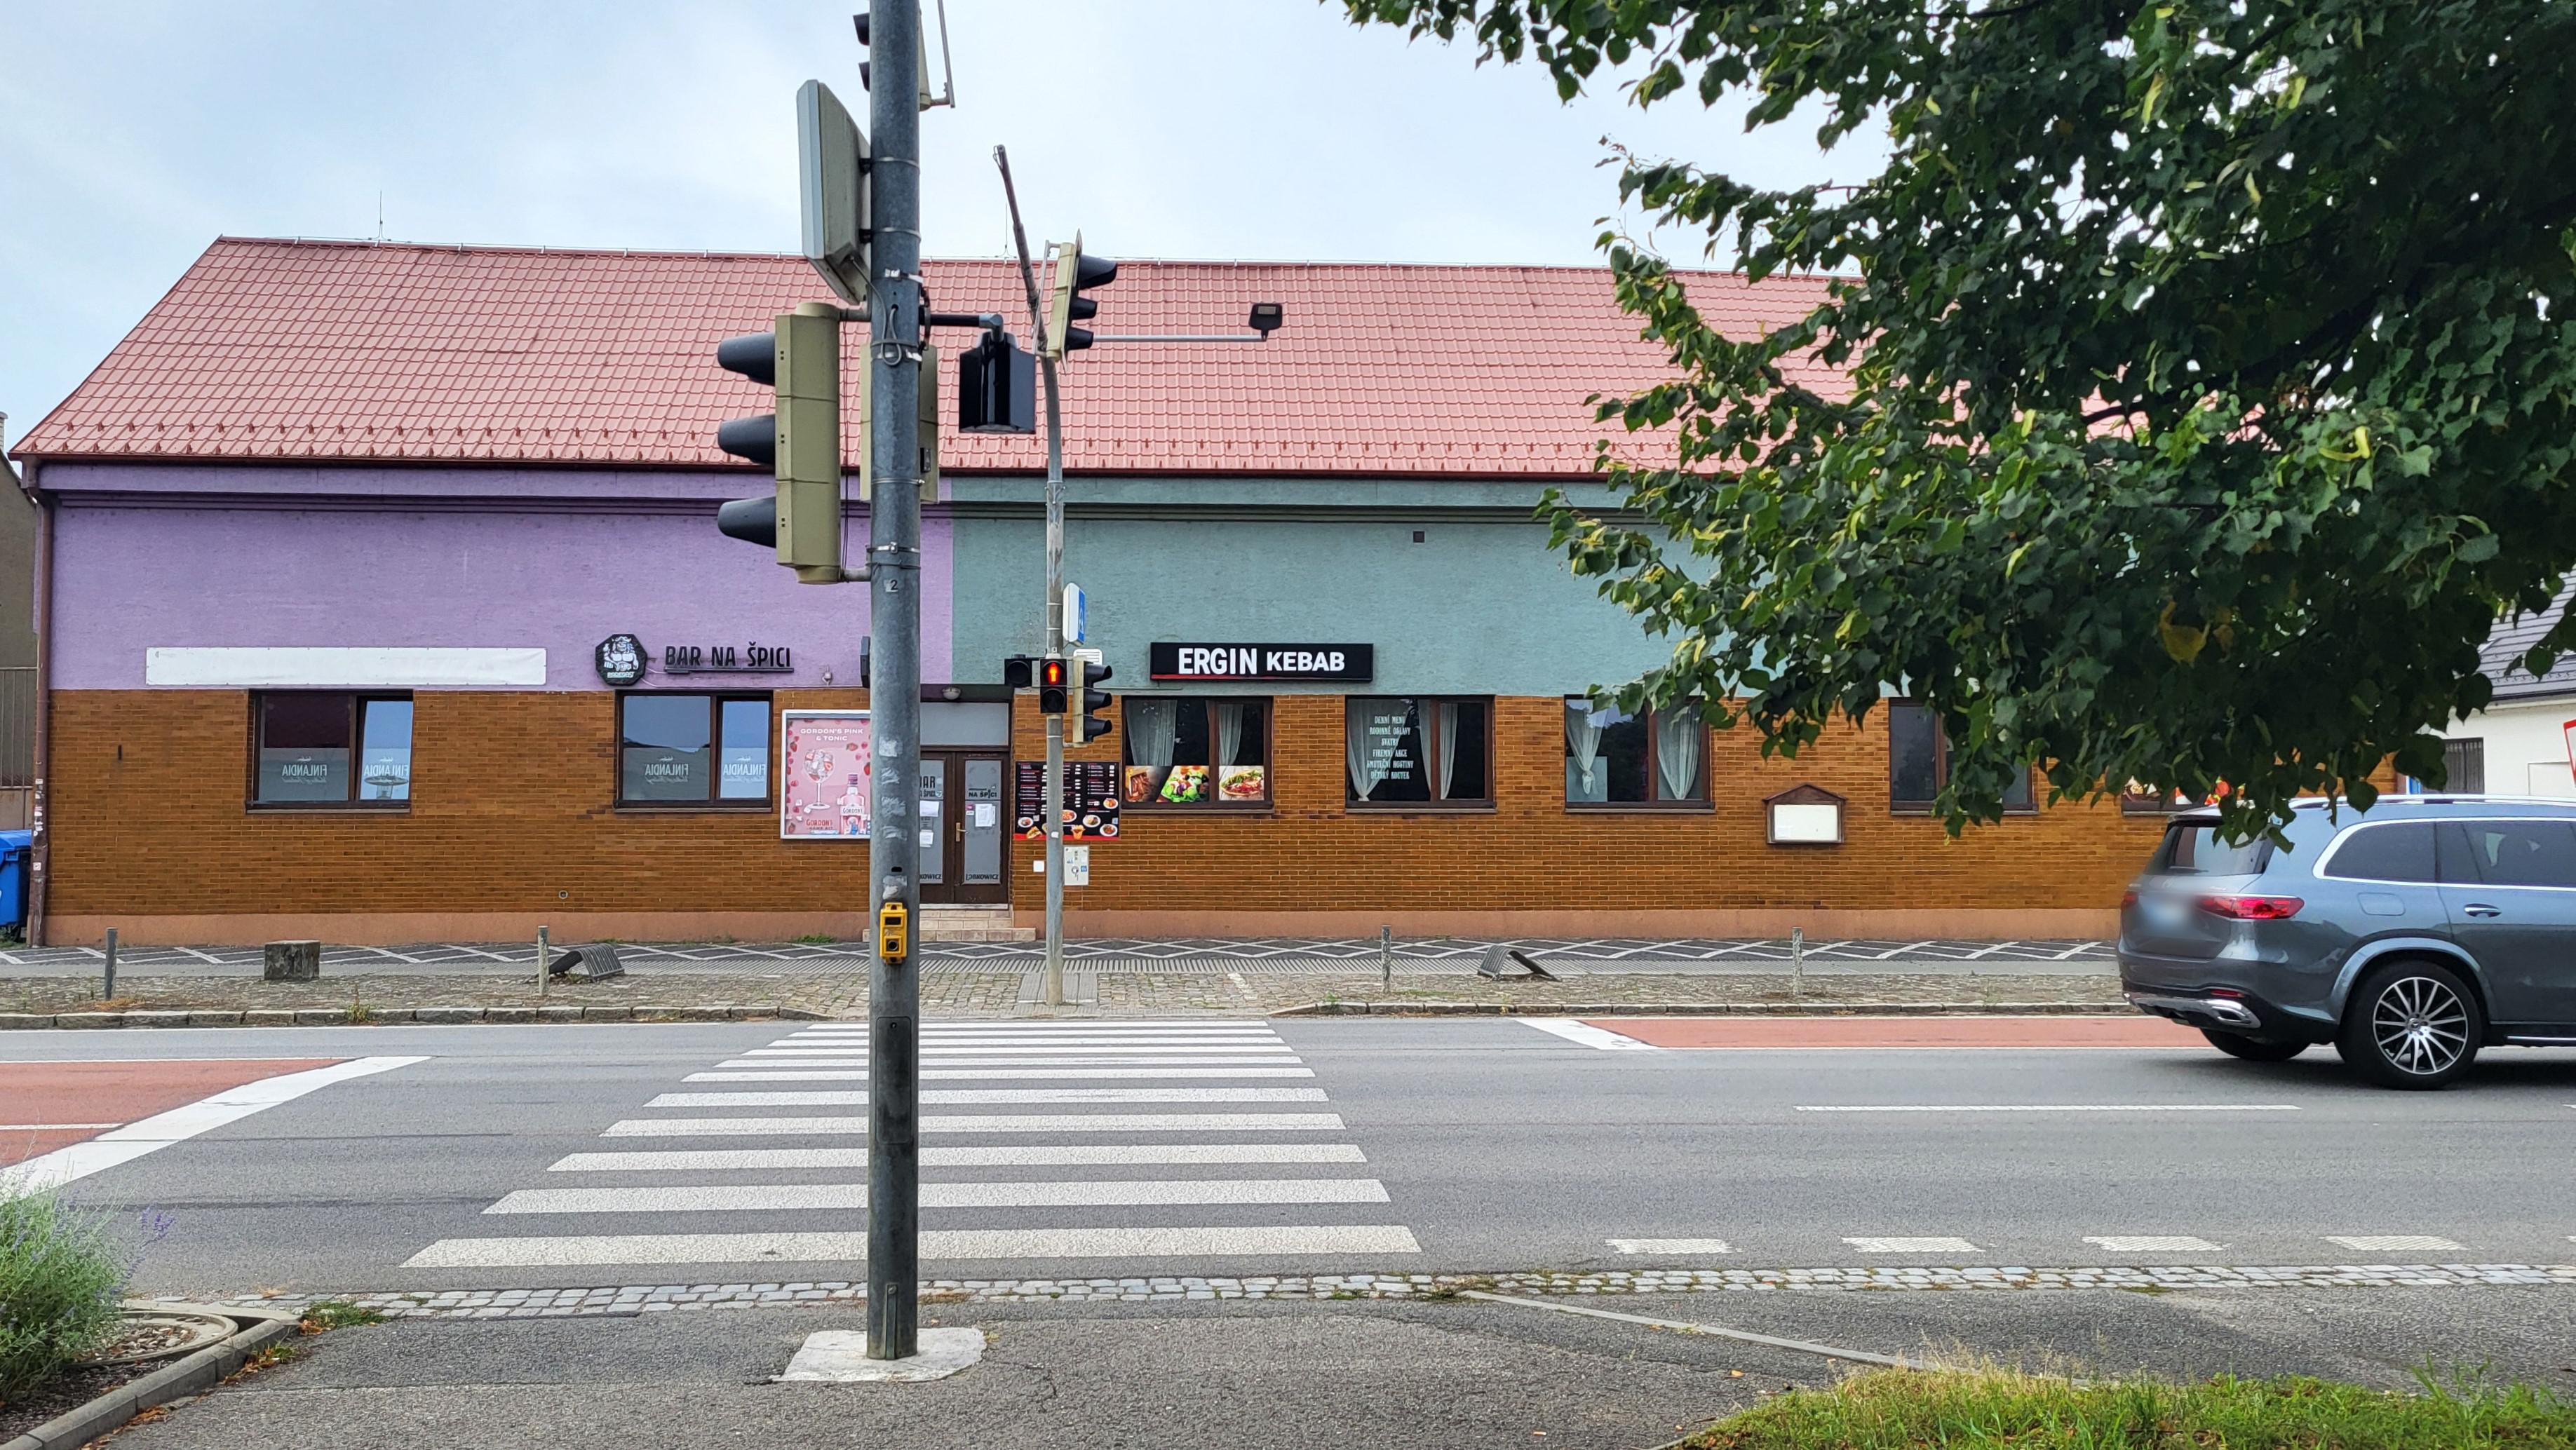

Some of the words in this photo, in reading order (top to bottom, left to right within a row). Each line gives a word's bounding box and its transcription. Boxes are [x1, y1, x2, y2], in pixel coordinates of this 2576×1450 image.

[666, 646, 701, 666] BAR
[711, 646, 736, 666] NA
[747, 642, 790, 667] ŠPICI
[1178, 648, 1257, 675] ERGIN
[1267, 651, 1344, 671] KEBAB
